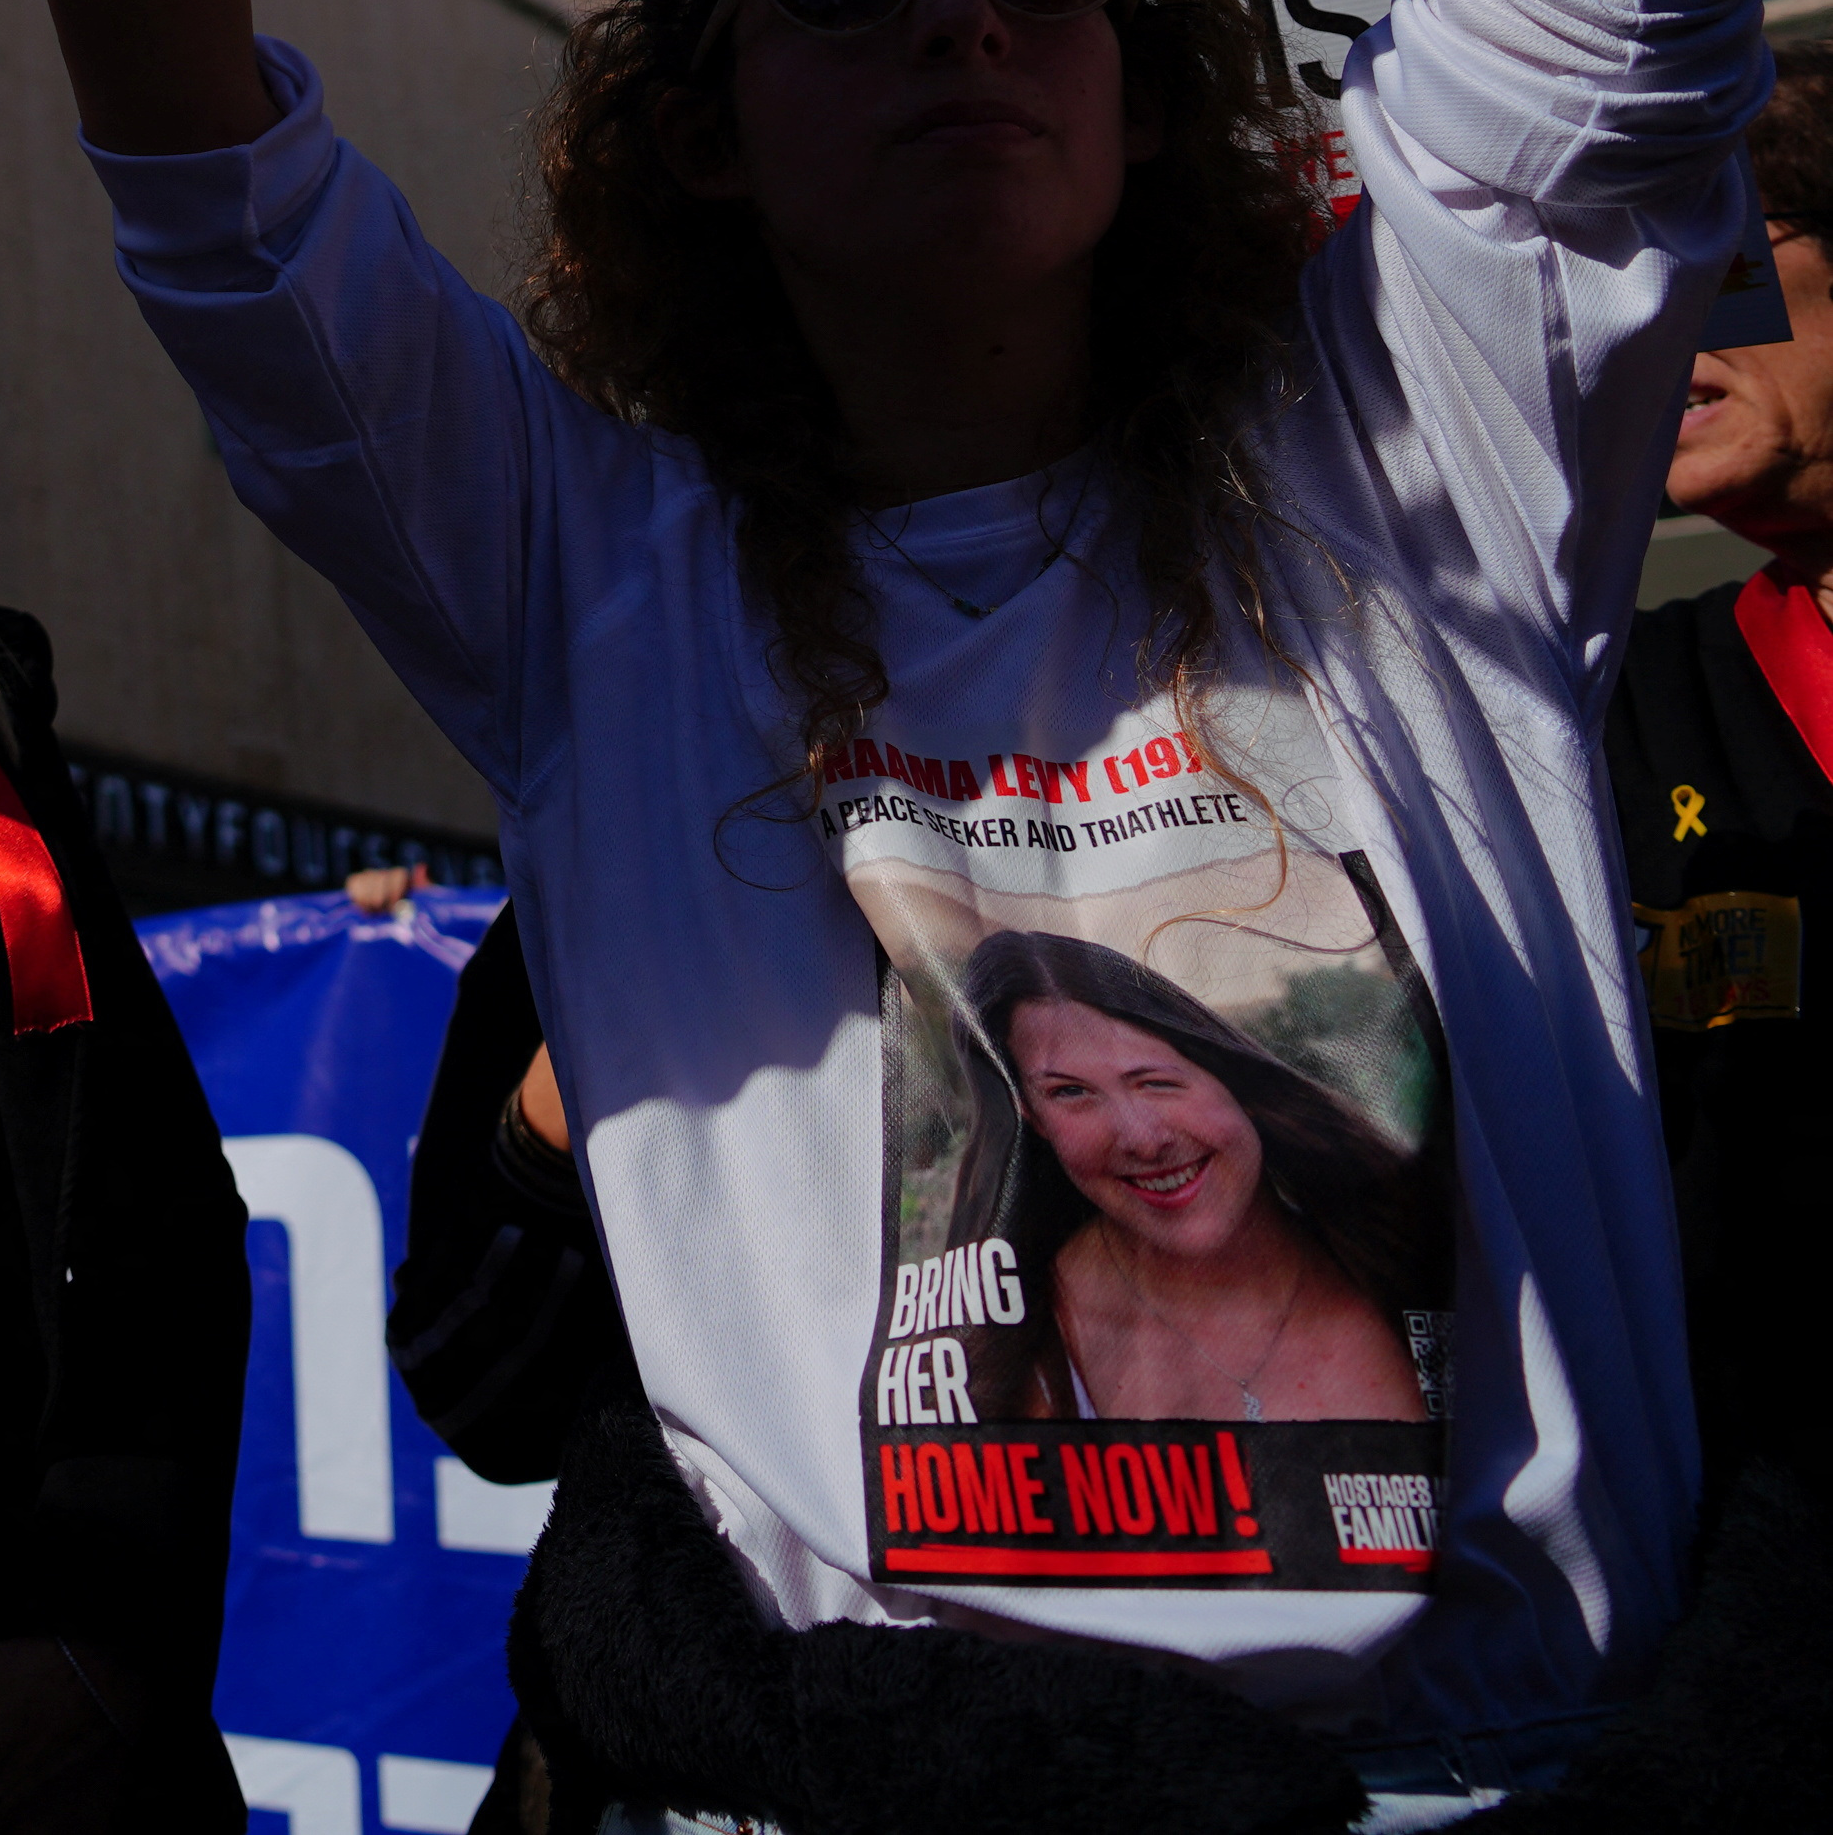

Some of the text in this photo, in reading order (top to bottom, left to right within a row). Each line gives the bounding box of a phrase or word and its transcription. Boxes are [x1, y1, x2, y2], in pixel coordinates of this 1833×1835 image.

[821, 738, 983, 803] NAAMA
[987, 752, 1092, 804] LEVY
[820, 793, 1249, 852] A PEACE SEEKER AND TRIATHLETE
[888, 1237, 1026, 1340] BRING
[876, 1336, 979, 1426] HER
[879, 1430, 1261, 1539] HOME NOW!
[1323, 1473, 1433, 1509] HOSTAGES
